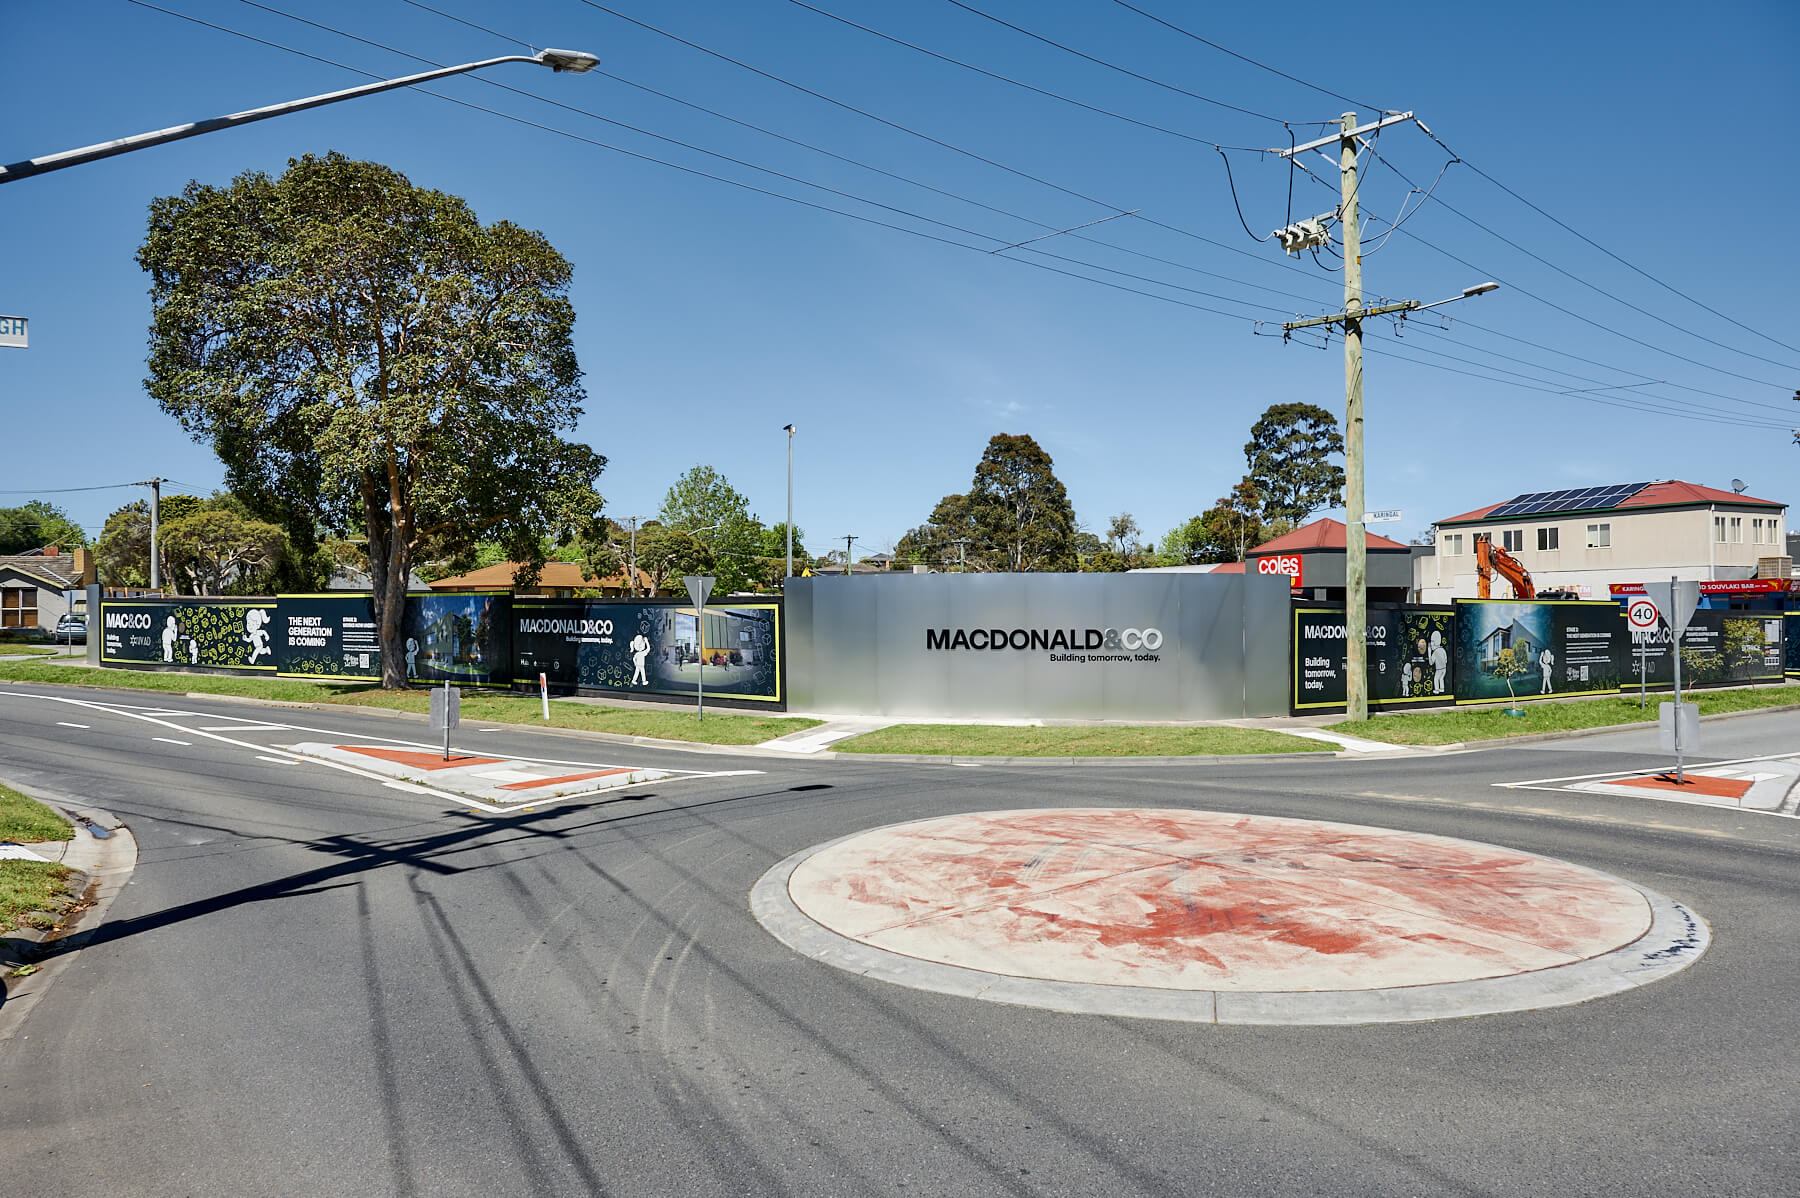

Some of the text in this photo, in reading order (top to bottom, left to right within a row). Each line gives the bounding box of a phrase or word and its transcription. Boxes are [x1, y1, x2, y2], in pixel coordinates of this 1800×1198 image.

[1258, 556, 1299, 575] coles
[1633, 608, 1653, 620] 40
[106, 613, 152, 629] MAC&CO
[288, 617, 322, 627] THE NEXT
[520, 618, 614, 635] MACDONALD&CO
[288, 628, 333, 637] GENERATION
[288, 639, 326, 648] IS COMING
[926, 628, 1163, 650] MACDONALD&CO
[1050, 653, 1161, 663] Building tomorrow, today.
[1304, 656, 1330, 668] Building
[1304, 669, 1336, 679] tomorrow,
[1304, 680, 1324, 690] today.
